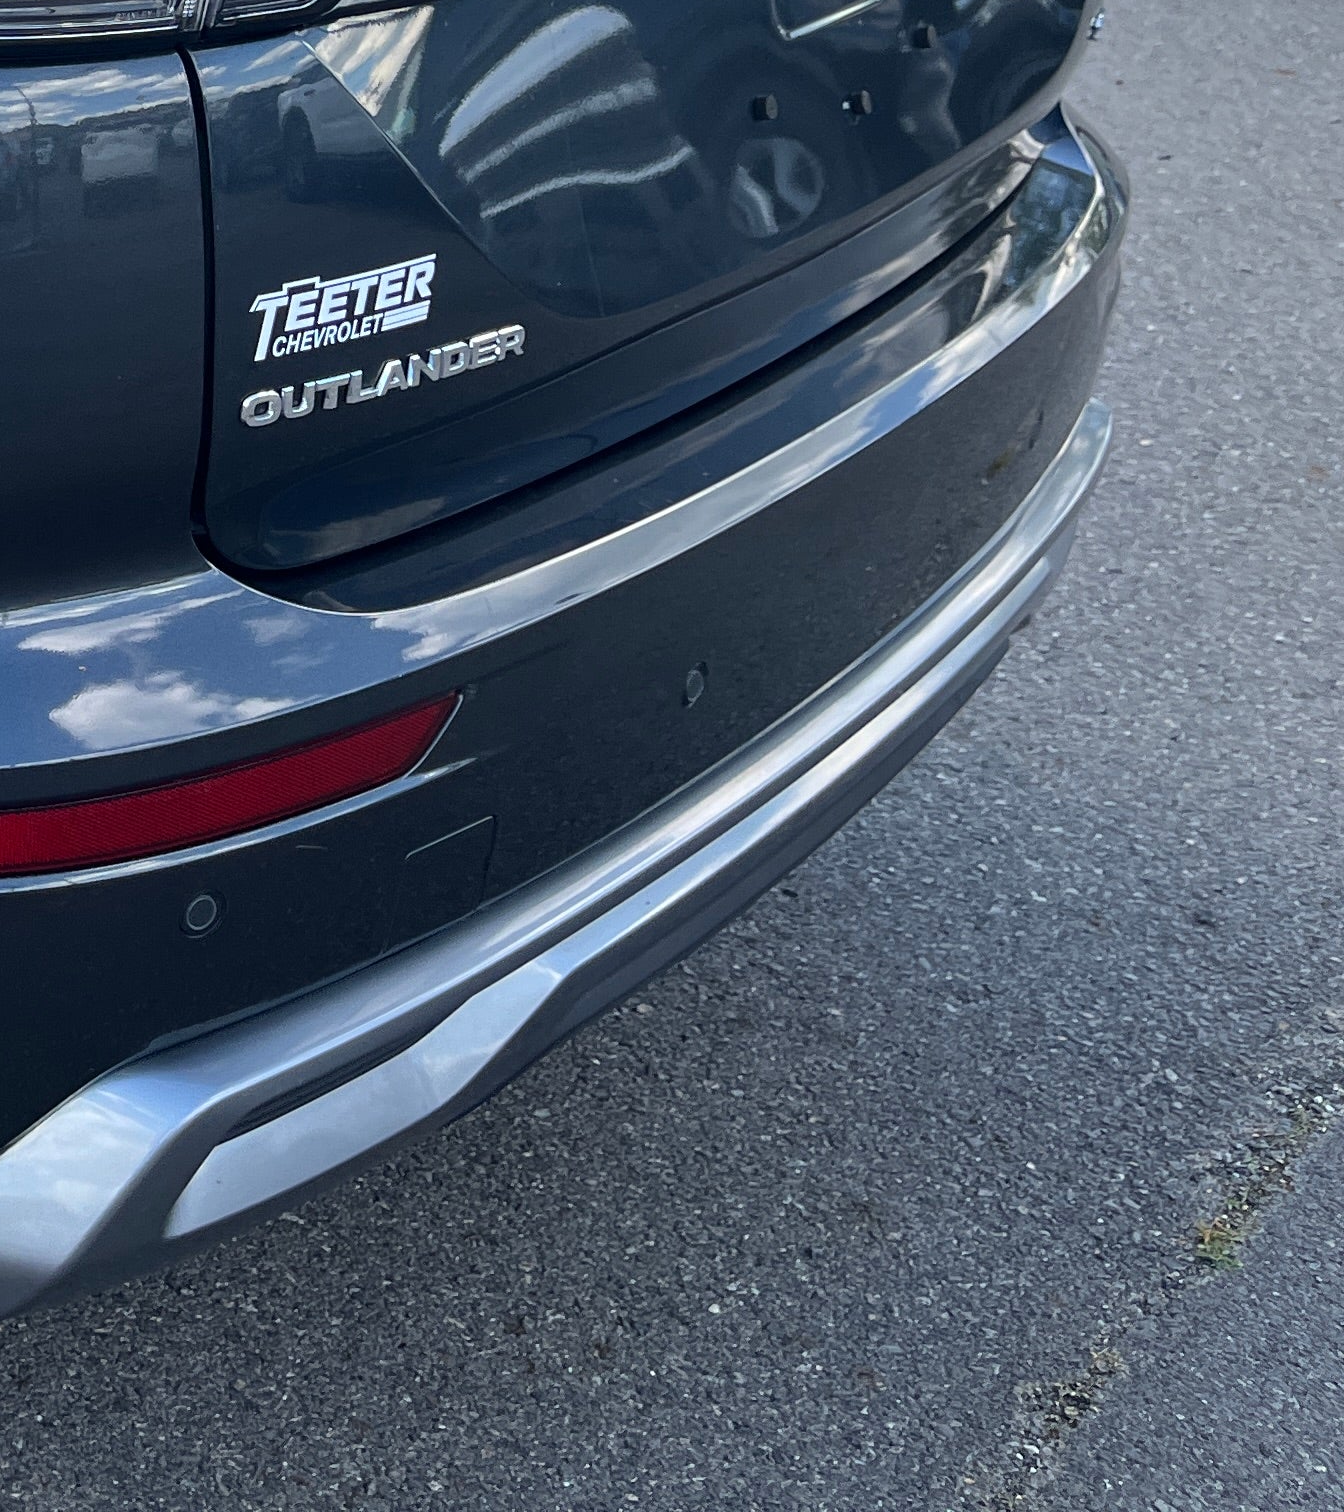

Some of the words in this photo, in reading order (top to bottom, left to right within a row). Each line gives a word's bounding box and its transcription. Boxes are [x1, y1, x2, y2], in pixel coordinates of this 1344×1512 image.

[252, 259, 436, 361] TEETER
[272, 312, 384, 357] CHEVROLET
[240, 324, 526, 427] OUTLANDER
